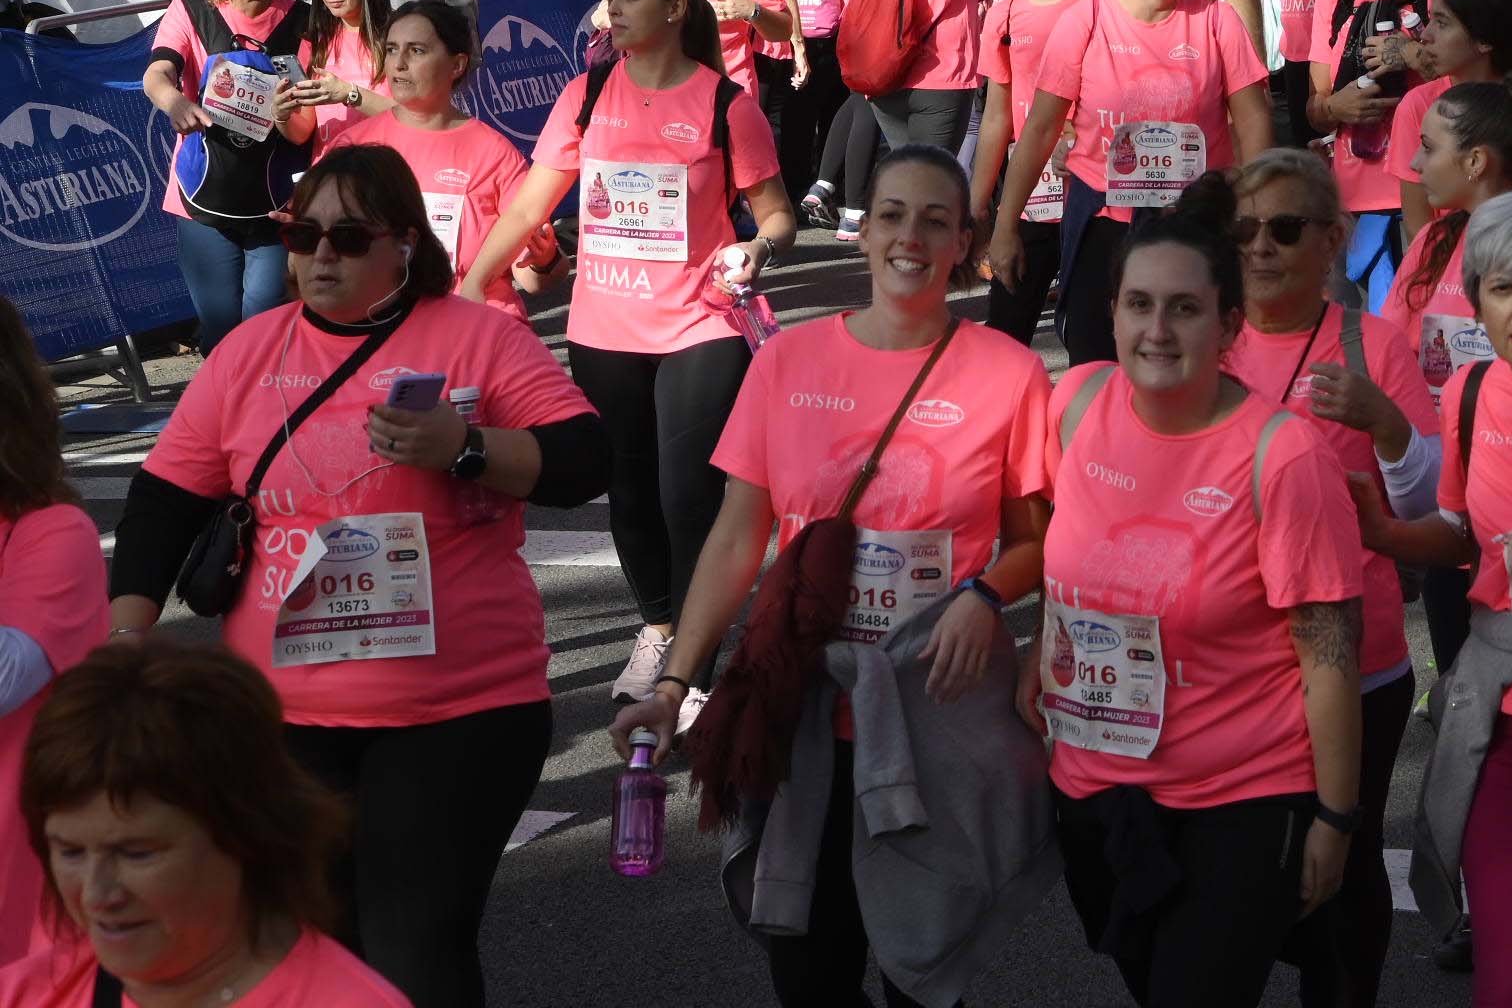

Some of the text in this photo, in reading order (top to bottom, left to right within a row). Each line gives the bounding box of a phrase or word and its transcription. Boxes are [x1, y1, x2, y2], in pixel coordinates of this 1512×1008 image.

[236, 87, 266, 105] 016
[236, 101, 260, 114] 18819
[1097, 109, 1125, 128] TU
[1138, 135, 1174, 144] ASTURIANA
[10, 139, 121, 175] CENTRAL LECHERA
[1139, 155, 1172, 167] 016
[611, 177, 650, 189] ASTURIANA
[1145, 171, 1166, 179] 5630
[0, 158, 144, 226] ASTURIANA
[1115, 193, 1145, 201] OYSHO
[614, 200, 649, 215] 016
[593, 227, 621, 236] CARRERA
[618, 217, 644, 228] 26961
[645, 245, 679, 253] Santander
[584, 258, 652, 291] SUMA
[259, 372, 323, 390] OYSHO
[789, 391, 856, 413] OYSHO
[1085, 461, 1137, 492] OYSHO
[258, 488, 296, 517] TU
[328, 531, 415, 555] TURIANA SUMA
[911, 549, 940, 558] SUMA
[320, 572, 375, 595] 016
[848, 584, 897, 609] 016
[327, 599, 370, 614] 13673
[288, 615, 418, 633] CARRERA DE LA MUJER 2023
[849, 611, 890, 628] 18484
[866, 632, 878, 642] LA
[1125, 630, 1152, 641] SUMA
[285, 634, 423, 656] OYSHO Santander
[1078, 661, 1117, 686] 016
[1055, 698, 1082, 716] CARRERA
[1091, 709, 1102, 718] LA
[1103, 711, 1130, 722] MUJER
[1132, 714, 1151, 724] 2023
[1049, 716, 1152, 746] OYSHO Santander
